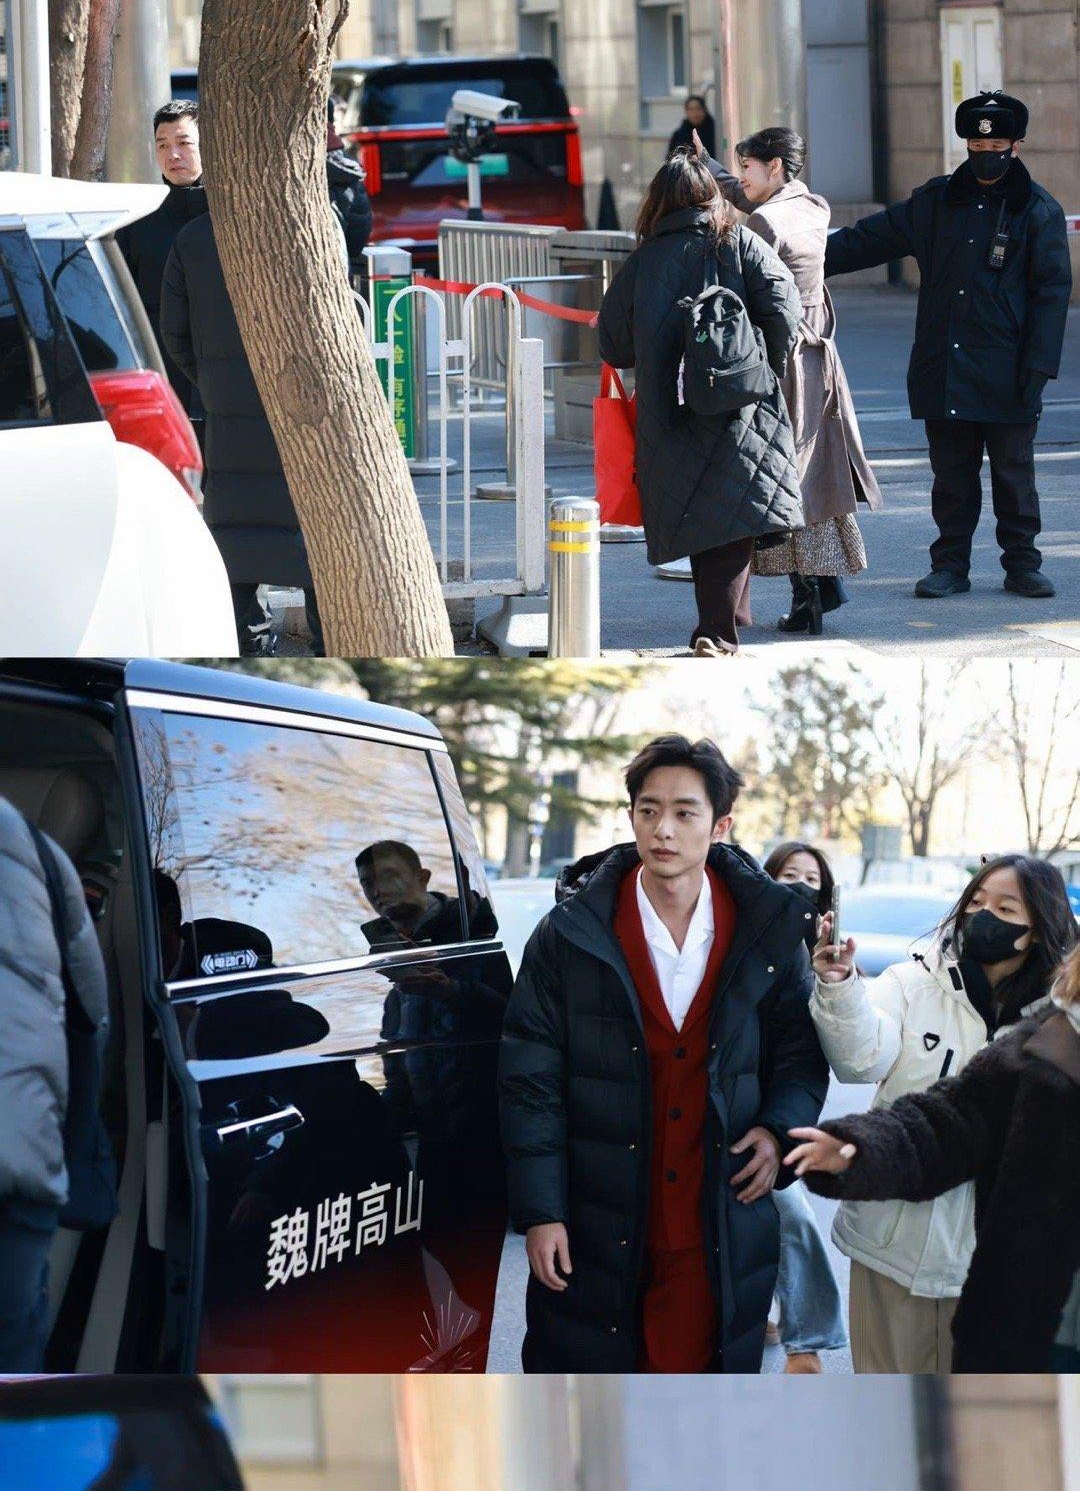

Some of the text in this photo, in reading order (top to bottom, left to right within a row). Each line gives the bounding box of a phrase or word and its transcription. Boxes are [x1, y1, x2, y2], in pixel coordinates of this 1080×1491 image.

[214, 954, 246, 968] 电动门
[265, 1171, 424, 1291] 魏牌高山
